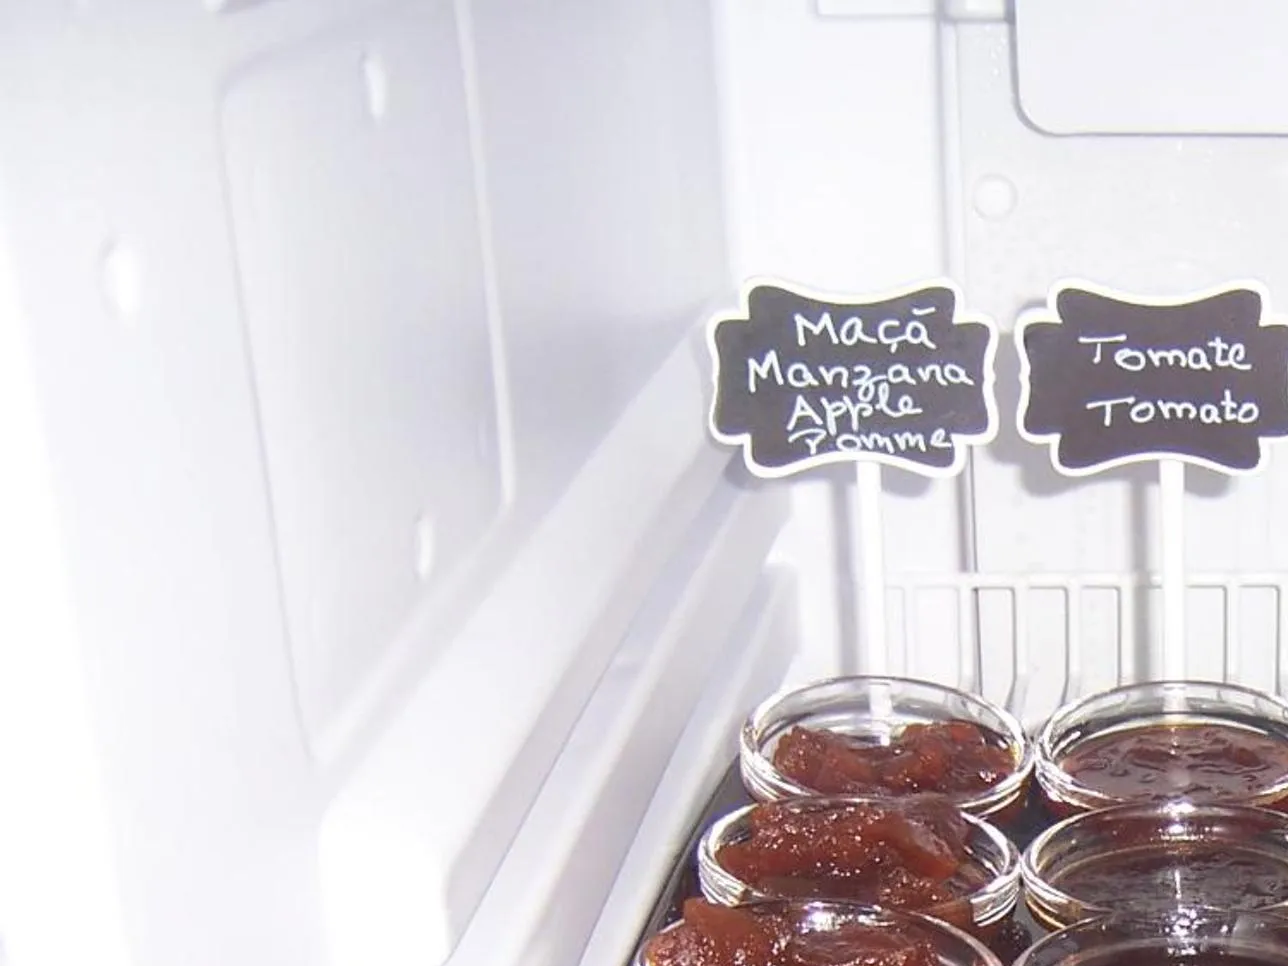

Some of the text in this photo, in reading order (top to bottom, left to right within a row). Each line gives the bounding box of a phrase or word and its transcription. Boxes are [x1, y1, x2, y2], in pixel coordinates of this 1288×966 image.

[1078, 333, 1252, 371] Tomate
[747, 349, 975, 402] Manzana
[786, 382, 923, 437] Apple
[1086, 388, 1259, 427] Tomato
[787, 428, 952, 455] Pomme
